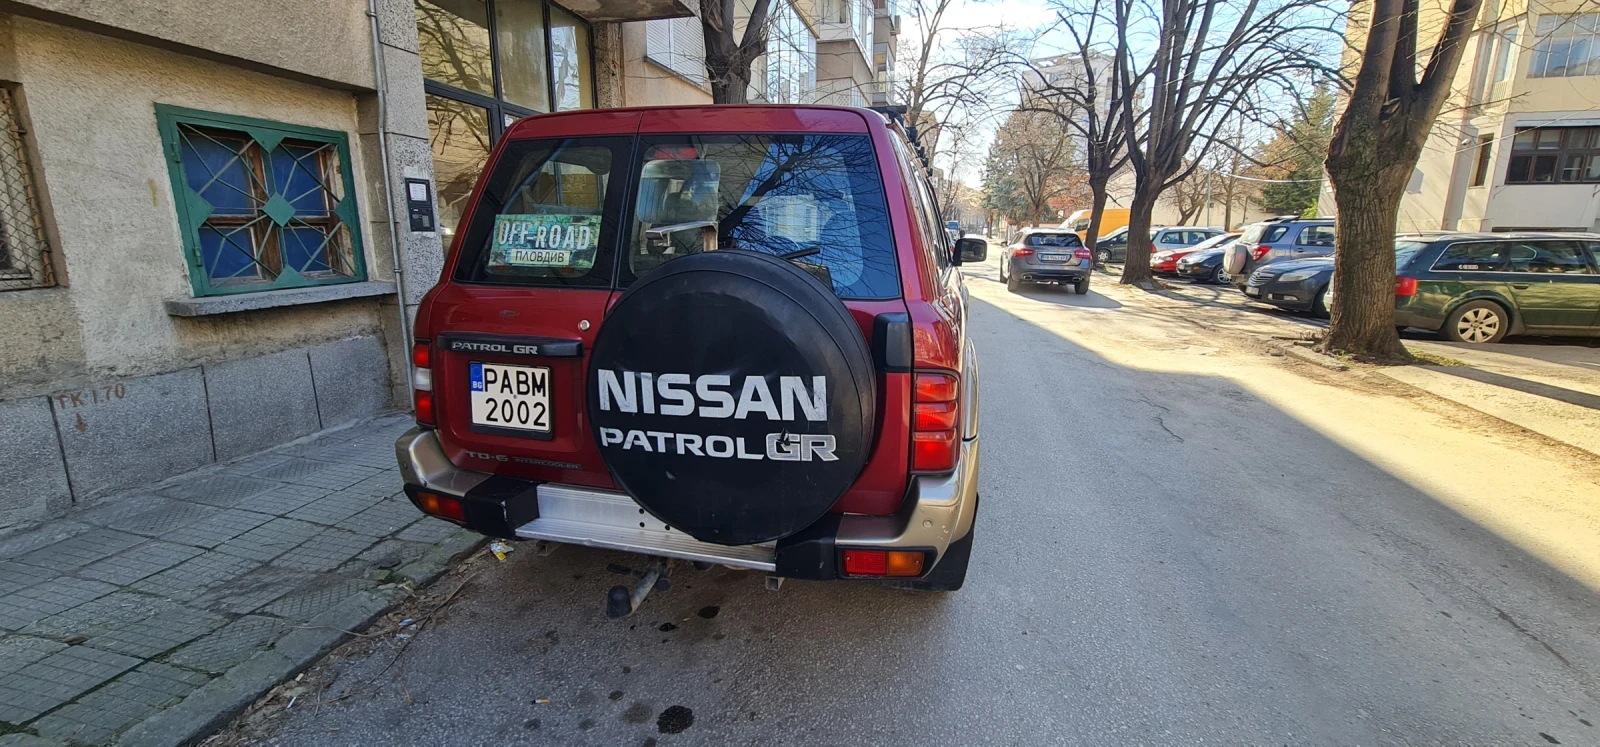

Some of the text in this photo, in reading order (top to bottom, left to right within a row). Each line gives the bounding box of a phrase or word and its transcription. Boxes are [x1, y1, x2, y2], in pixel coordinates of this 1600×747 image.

[498, 220, 591, 250] OFF-ROAD
[515, 251, 565, 263] ПЛОВДИВ
[452, 341, 511, 353] PATROL
[472, 381, 482, 389] BG
[484, 368, 546, 397] PABM
[598, 368, 828, 422] NISSAN
[485, 397, 547, 427] 2002
[599, 426, 765, 460] PATROL
